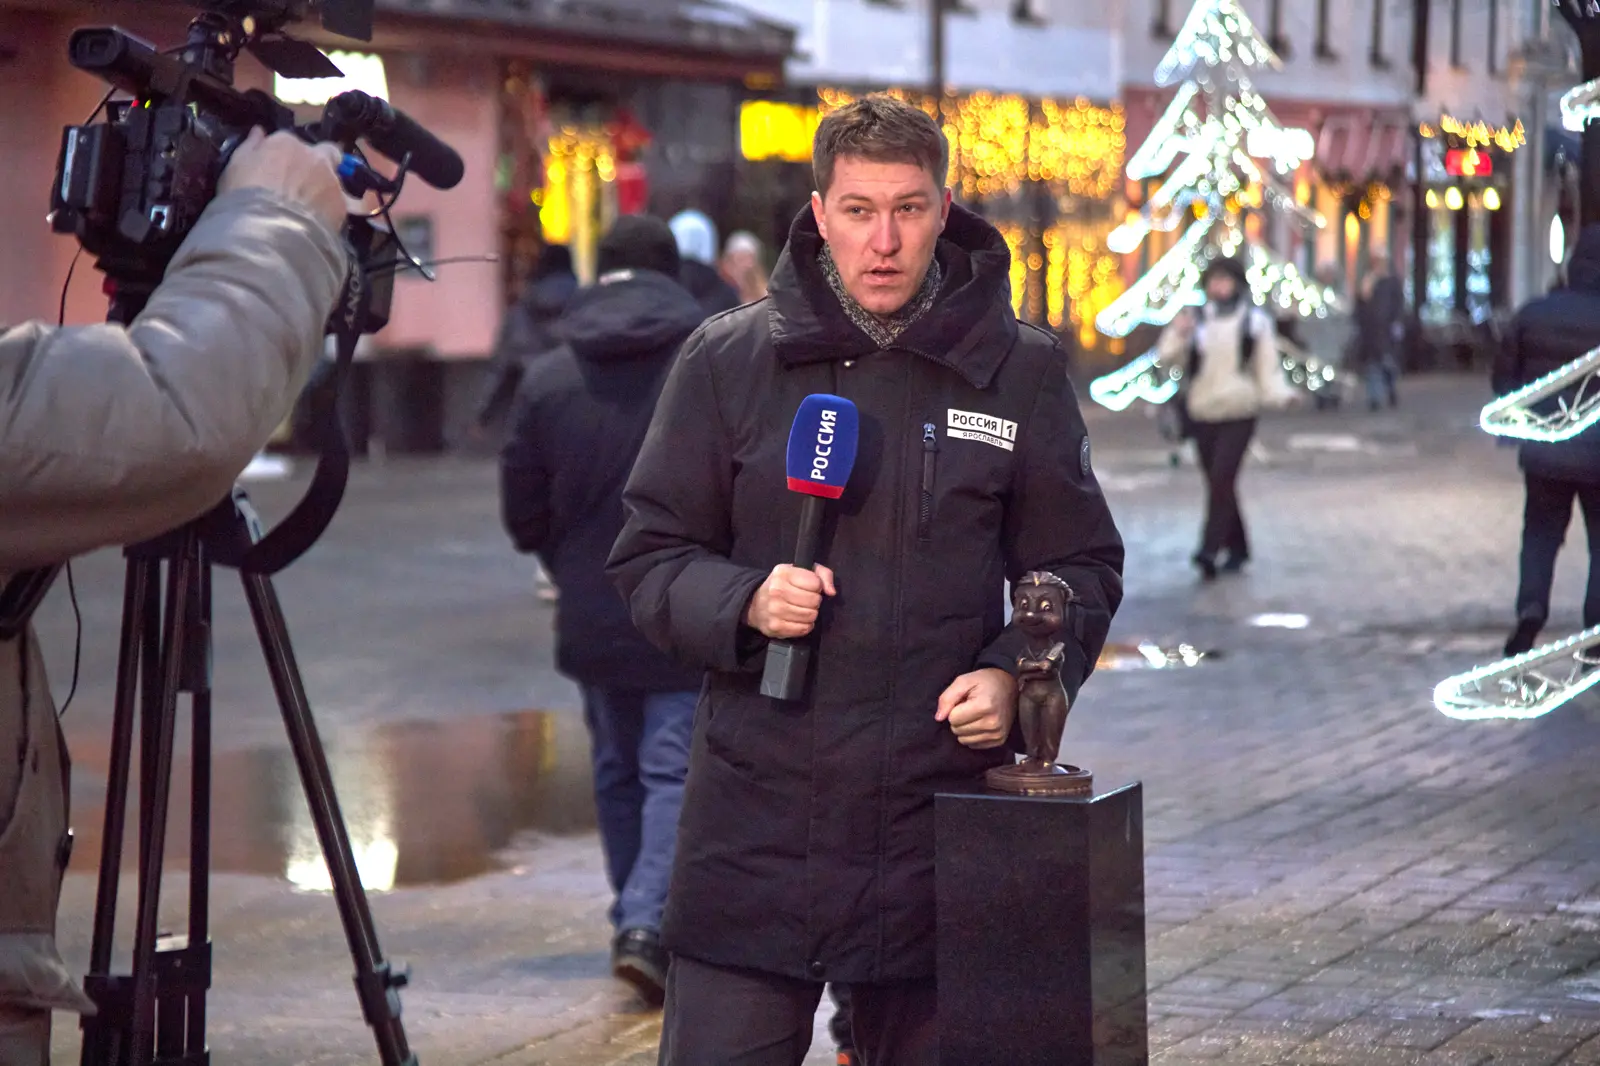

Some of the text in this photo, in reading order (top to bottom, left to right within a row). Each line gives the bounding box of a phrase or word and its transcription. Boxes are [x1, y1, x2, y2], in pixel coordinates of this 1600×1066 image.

[344, 261, 360, 331] SONY
[810, 409, 837, 481] РОССИЯ
[952, 413, 1014, 438] РОССИЯ 1
[962, 431, 1004, 447] ЯРОСЛАВЛЬ
